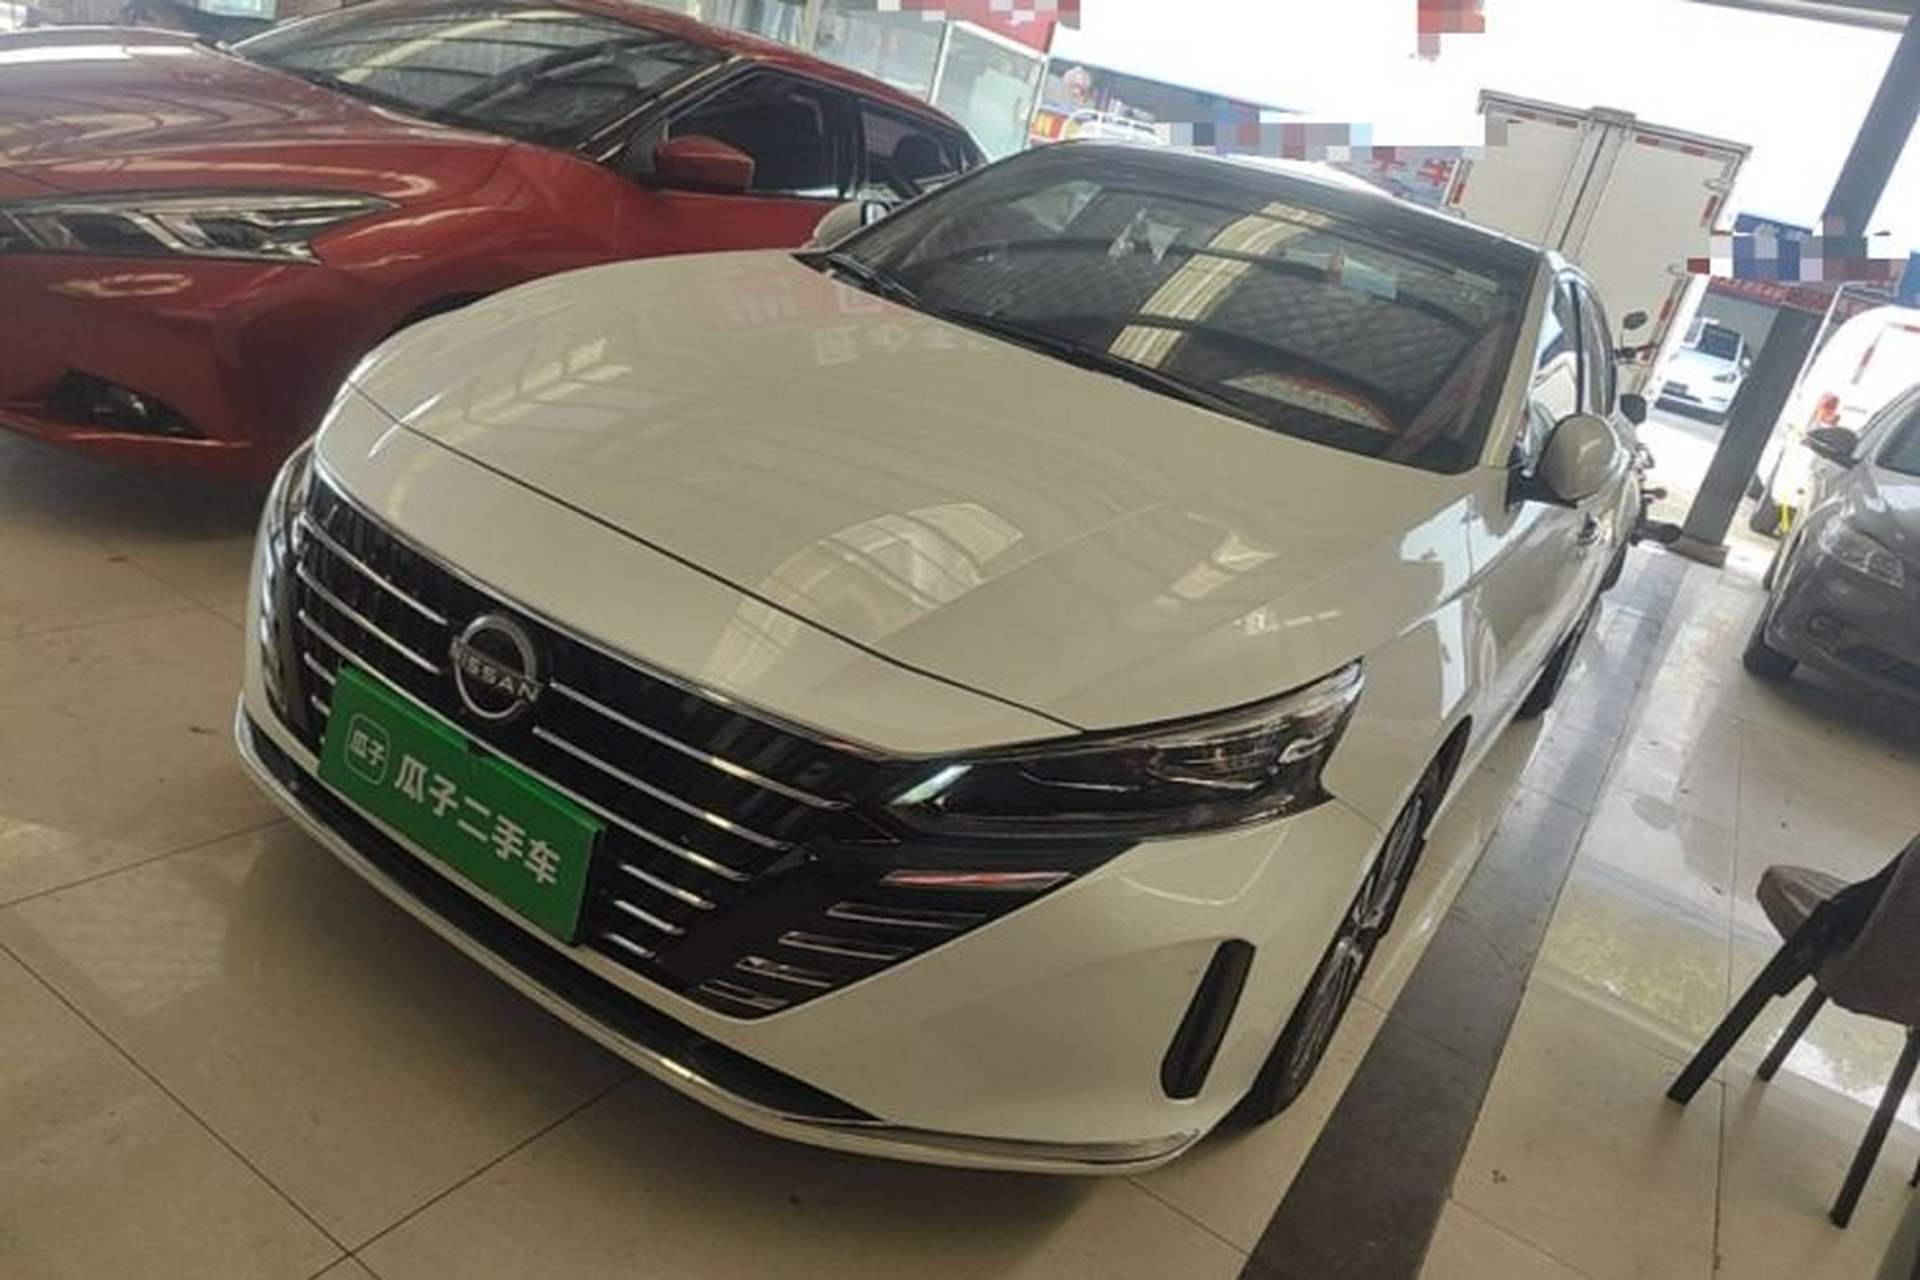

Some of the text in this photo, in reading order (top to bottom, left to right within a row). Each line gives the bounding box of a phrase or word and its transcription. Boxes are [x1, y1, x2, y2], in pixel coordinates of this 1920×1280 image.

[449, 637, 541, 702] NISSAN
[394, 754, 561, 885] 瓜子二手车
